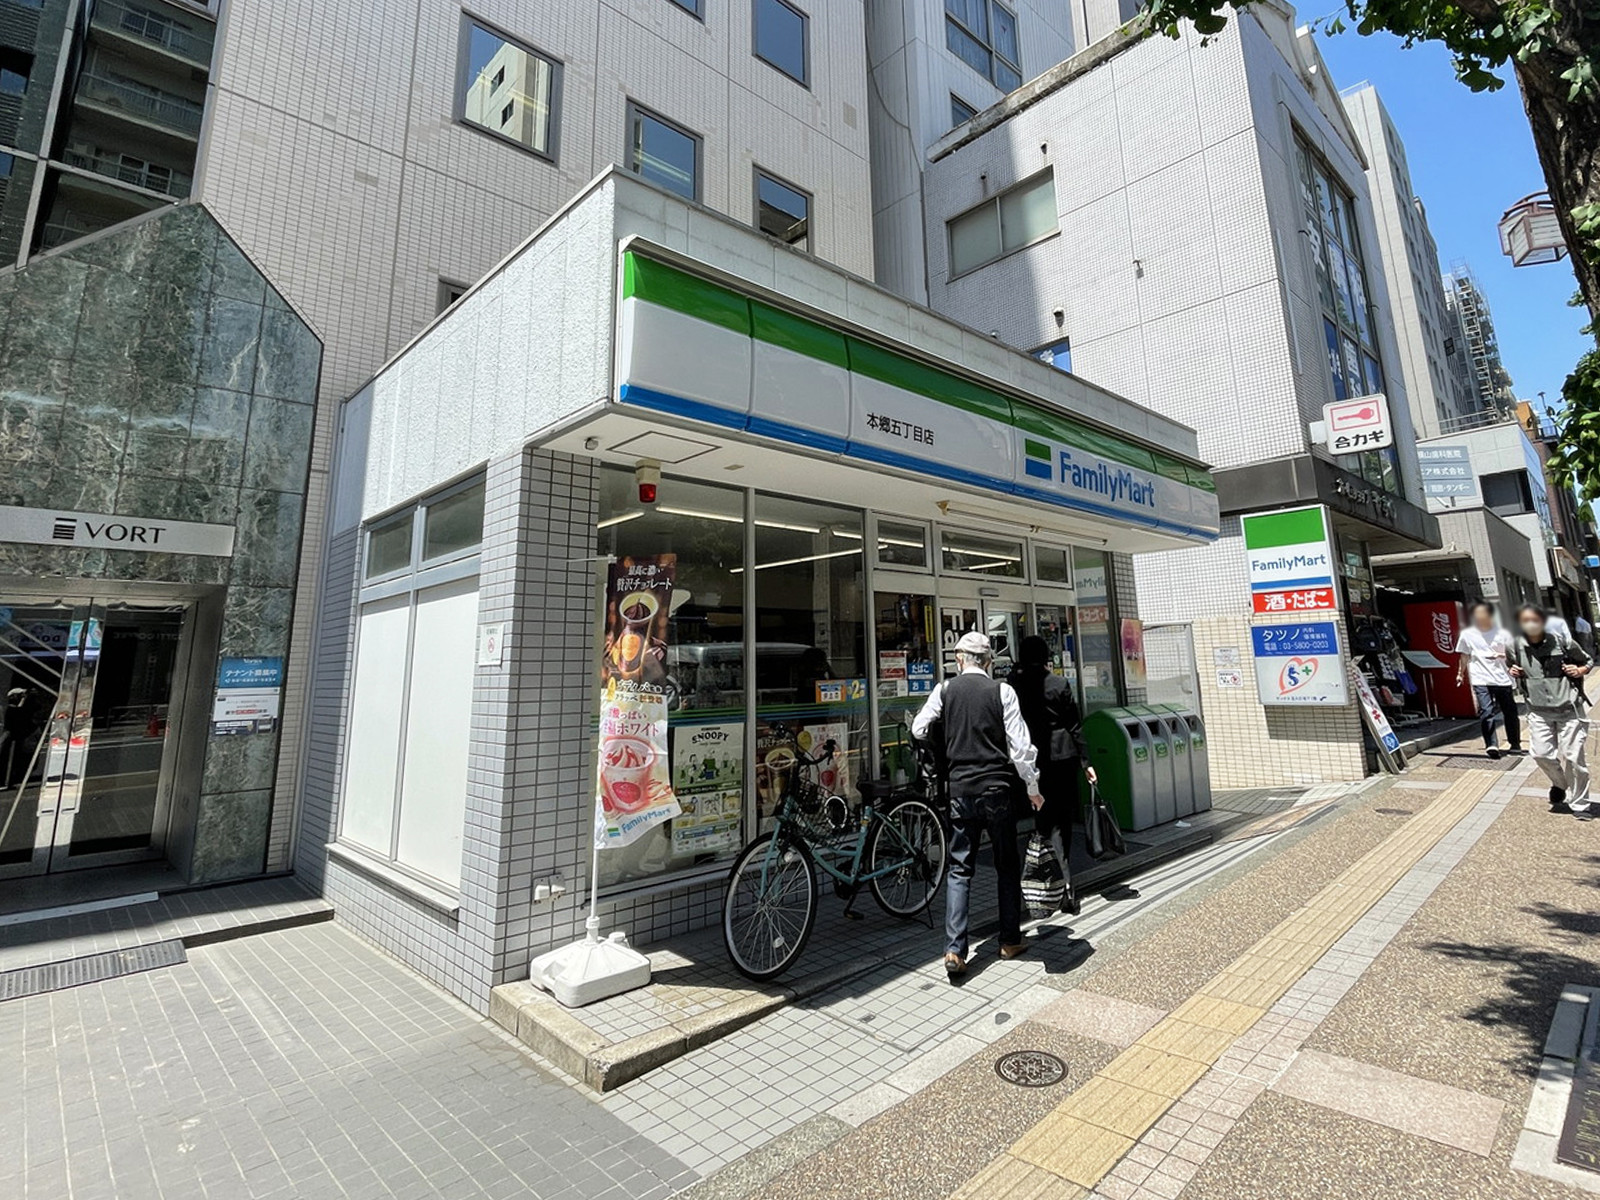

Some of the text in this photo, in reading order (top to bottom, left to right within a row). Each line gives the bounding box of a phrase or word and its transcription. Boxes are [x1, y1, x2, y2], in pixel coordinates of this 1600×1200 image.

[866, 412, 935, 446] 本郷五丁目店
[1334, 429, 1385, 449] 合カギ
[1059, 450, 1155, 508] FamilyMart
[84, 521, 167, 543] VORT
[1251, 554, 1326, 572] FamilyMart
[1264, 590, 1330, 611] 酒・たばこ
[1262, 628, 1300, 642] タツノ
[911, 663, 930, 674] たばこ
[691, 730, 730, 745] SNOOPY
[621, 808, 672, 833] FamilyMart
